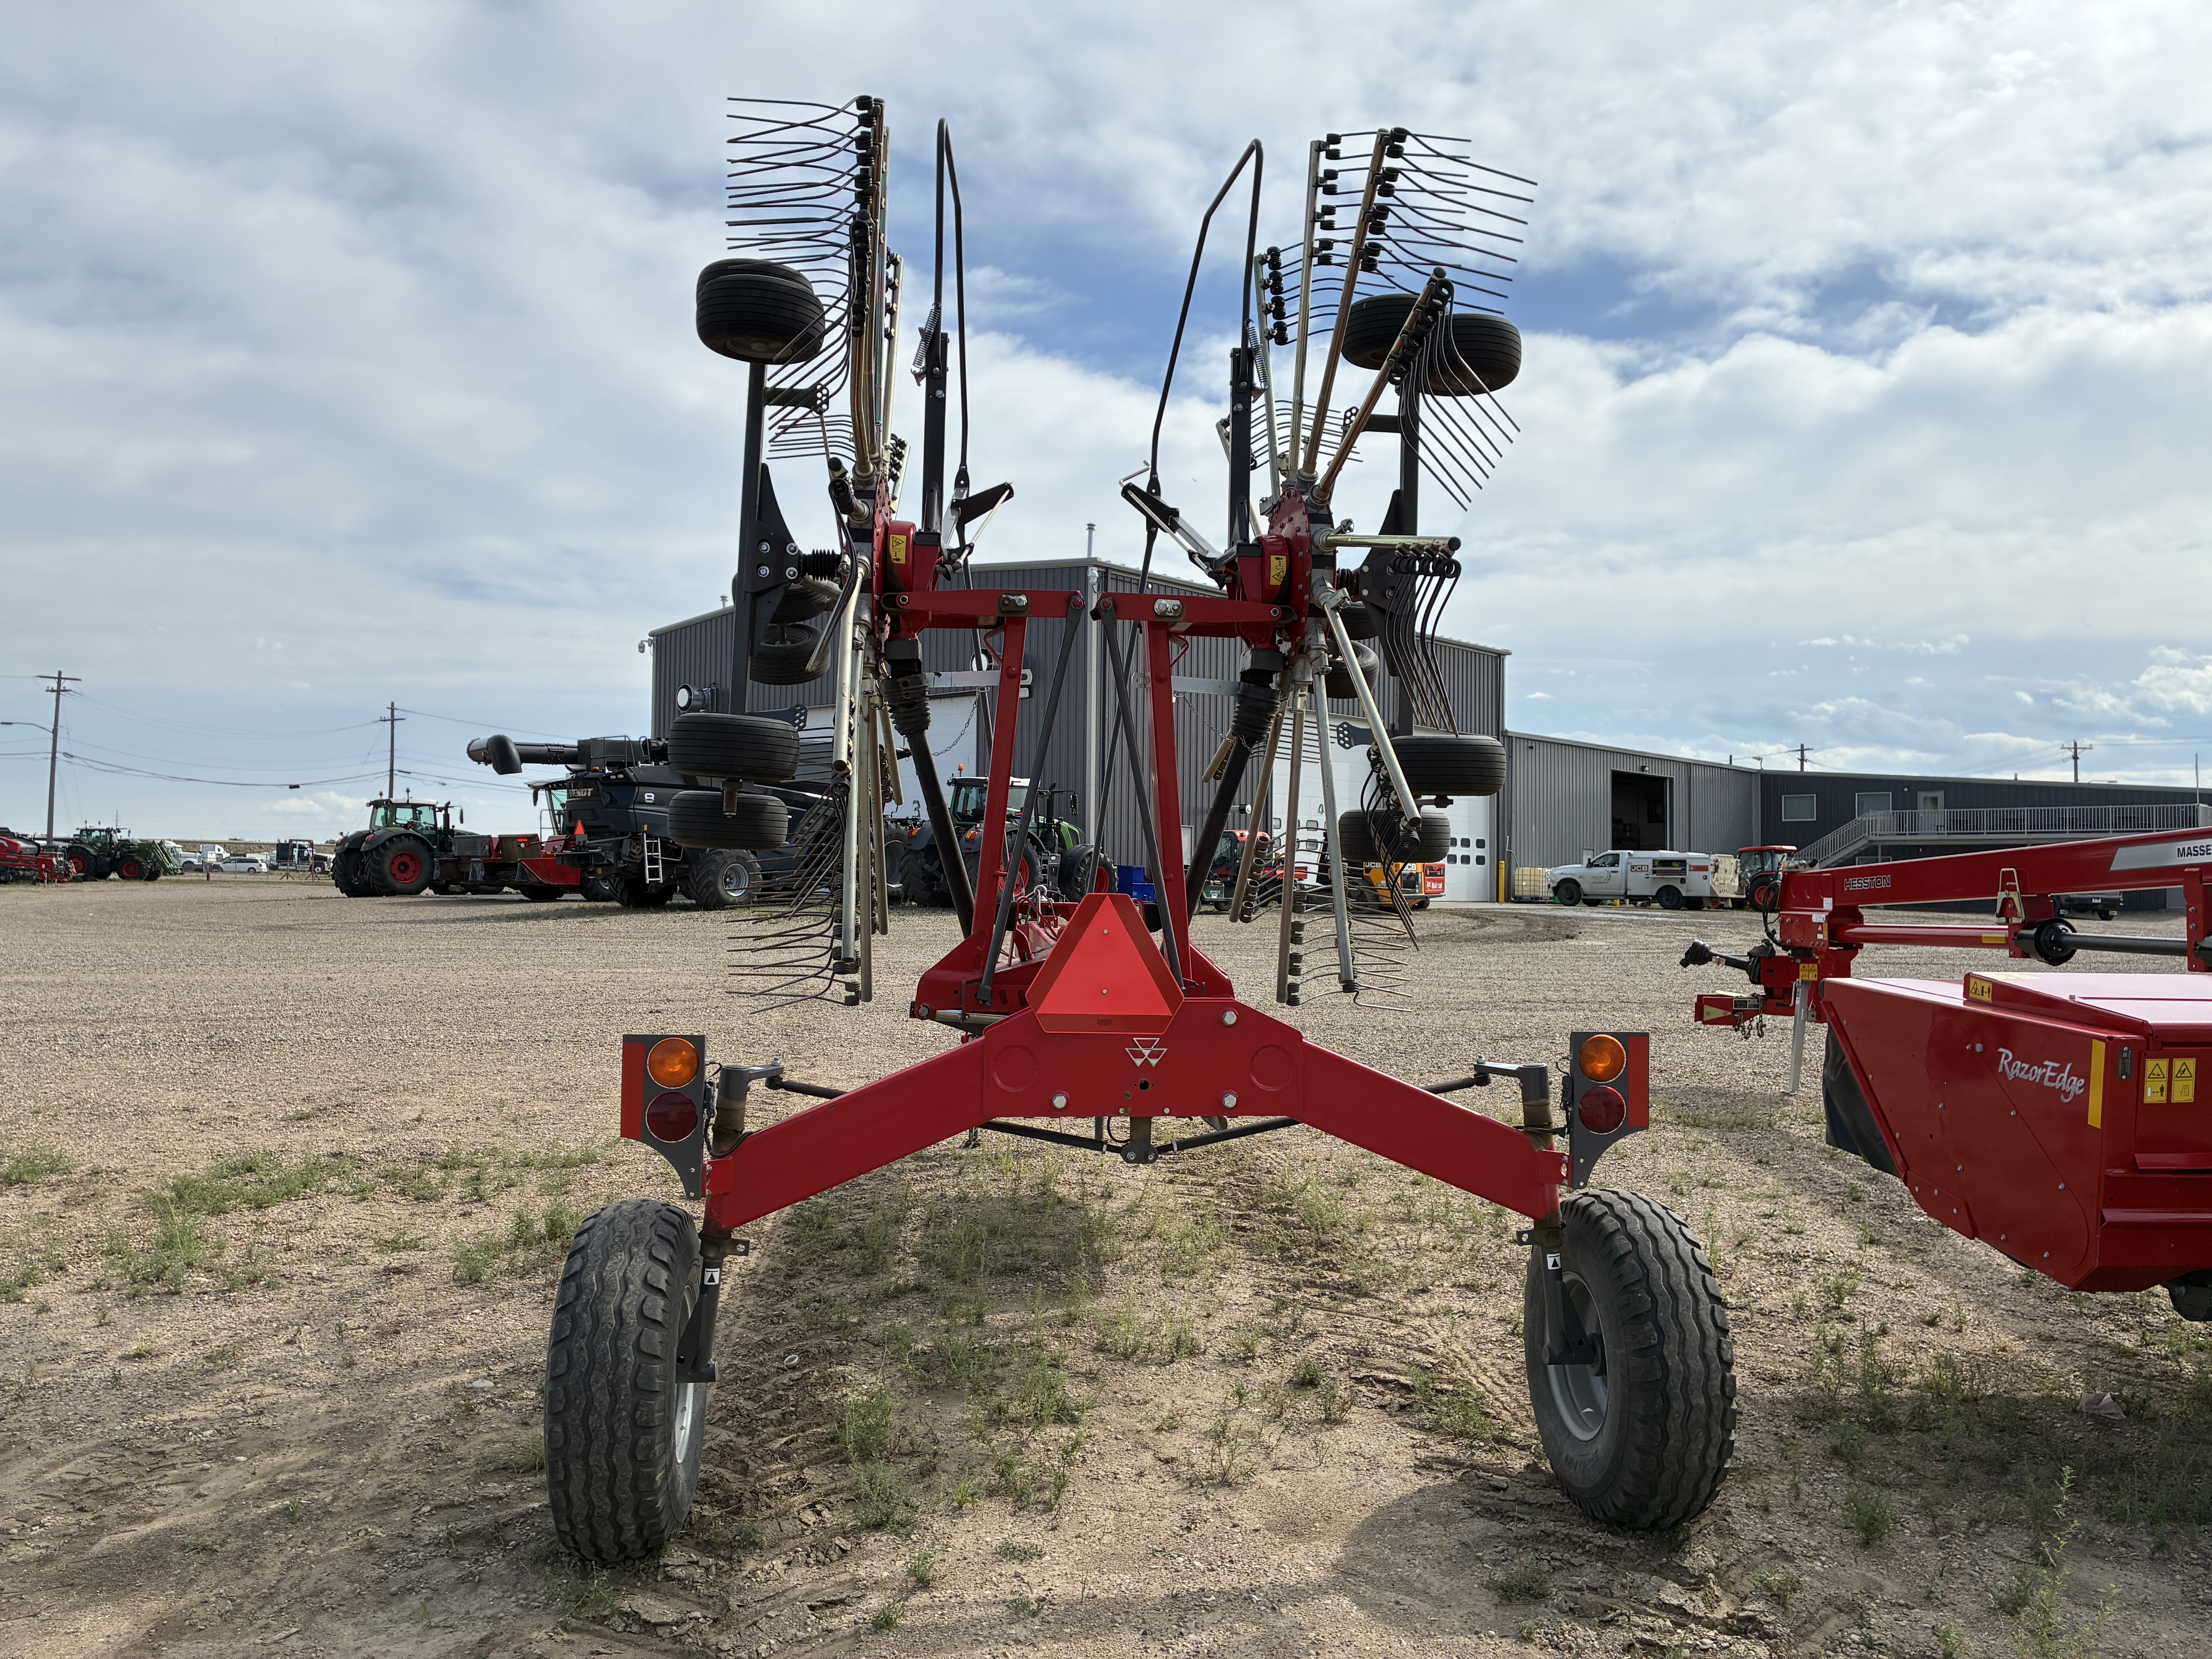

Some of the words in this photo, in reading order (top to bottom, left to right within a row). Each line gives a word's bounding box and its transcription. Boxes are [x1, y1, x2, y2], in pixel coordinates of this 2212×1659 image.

[569, 788, 593, 797] FENDT
[644, 793, 654, 803] 8
[2177, 844, 2212, 858] MASSE
[1844, 875, 1891, 890] HESSTON
[1997, 1047, 2085, 1103] RazorEdge
